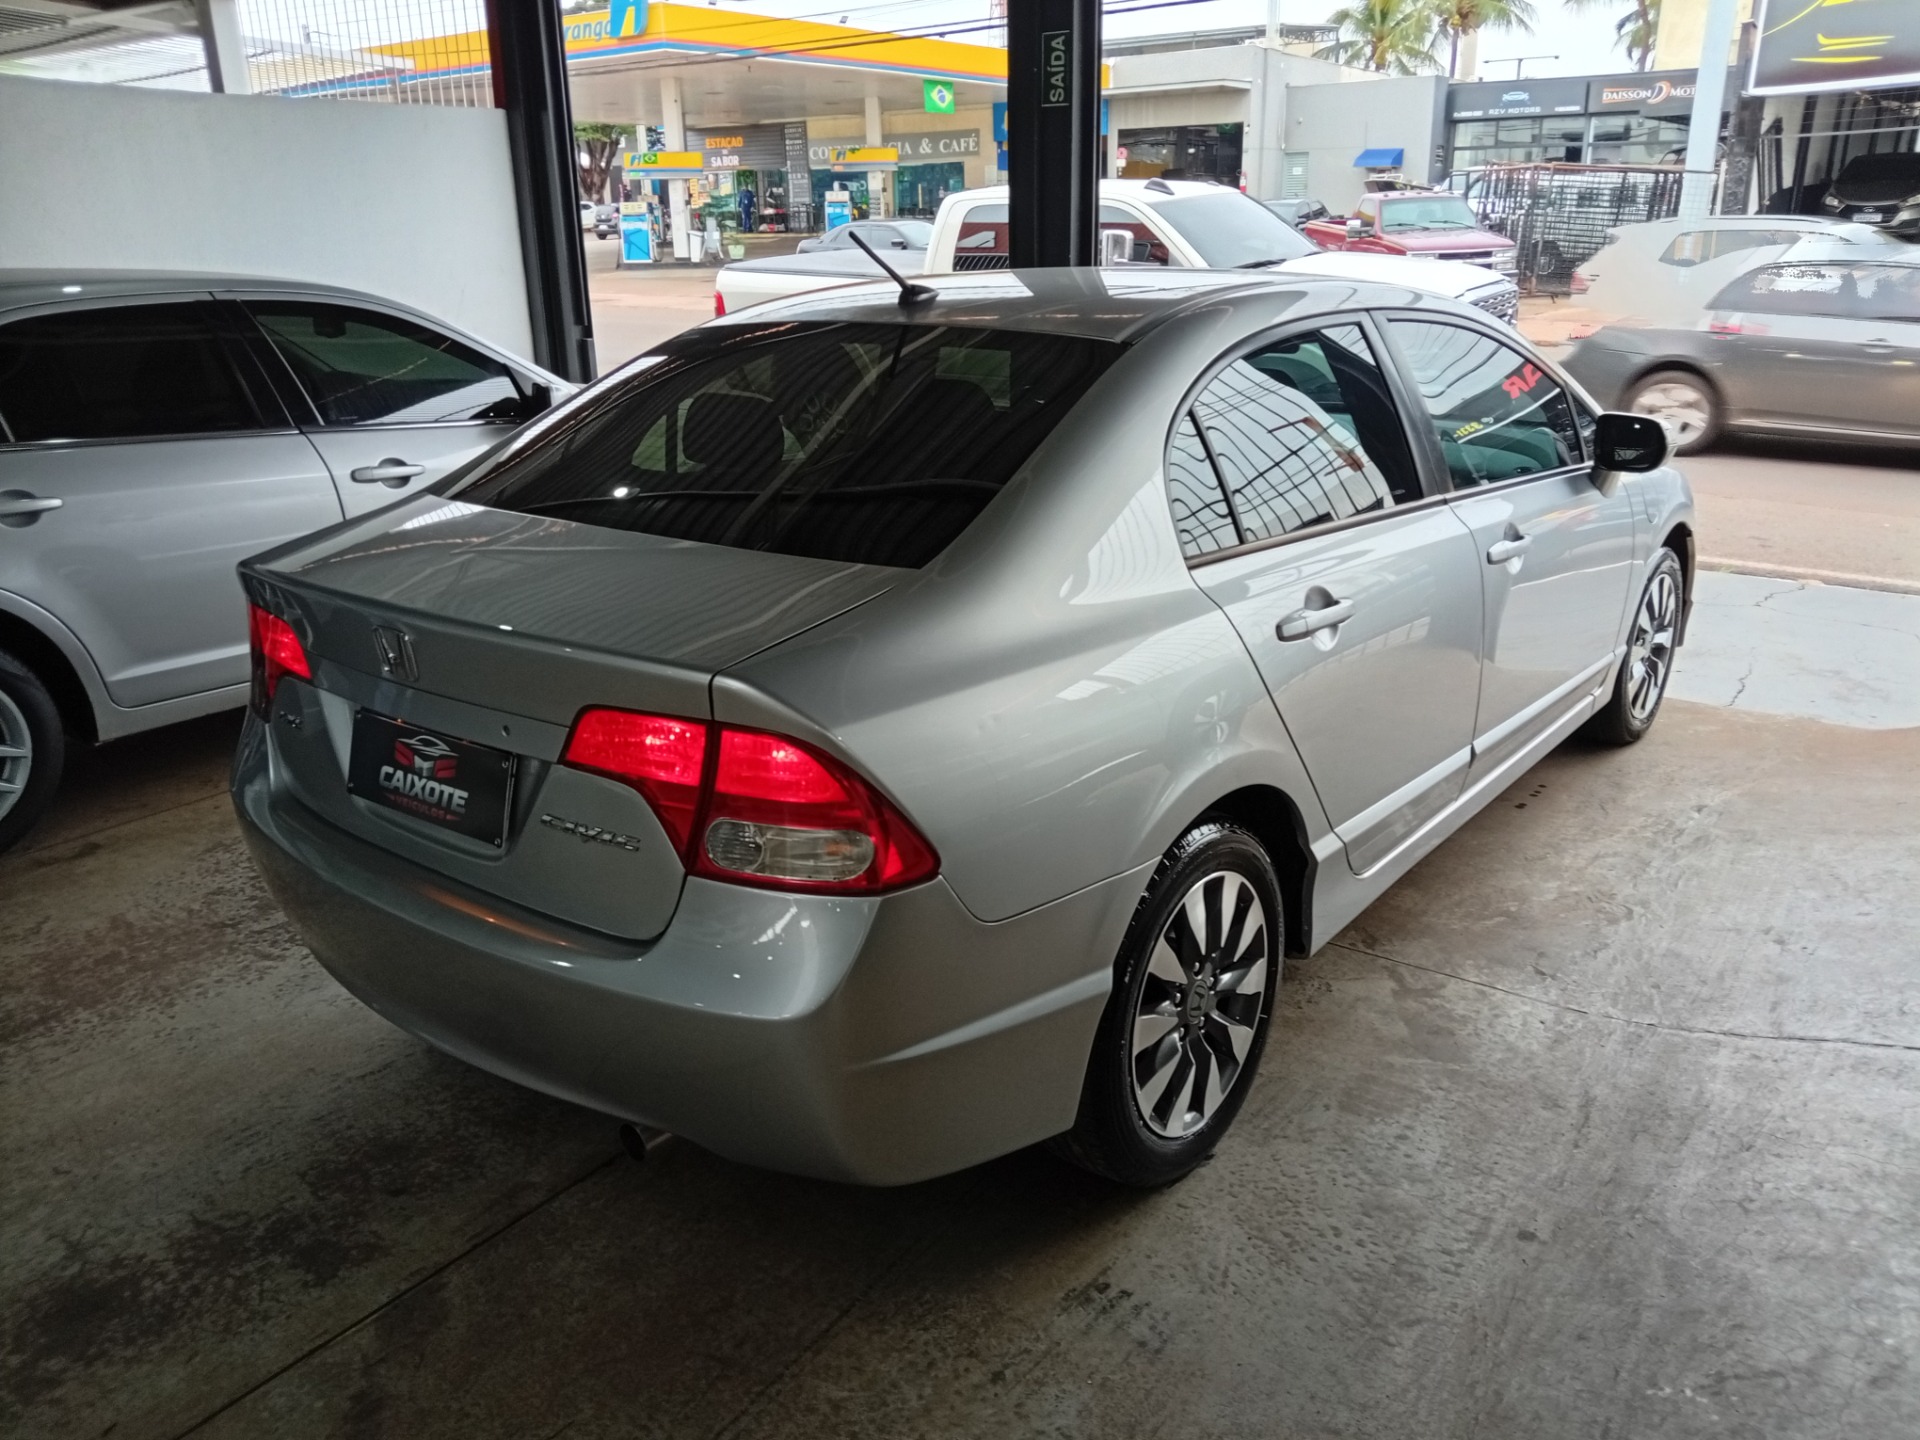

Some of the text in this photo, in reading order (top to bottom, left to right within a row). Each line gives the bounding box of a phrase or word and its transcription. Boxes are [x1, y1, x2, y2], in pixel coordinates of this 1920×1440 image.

[1047, 35, 1065, 102] SAÍDA
[1602, 90, 1651, 101] DAISSON
[1508, 106, 1541, 114] MOTORS
[939, 133, 978, 153] CAFÉ
[711, 156, 739, 168] SABOR
[379, 765, 469, 814] CAIXOTE
